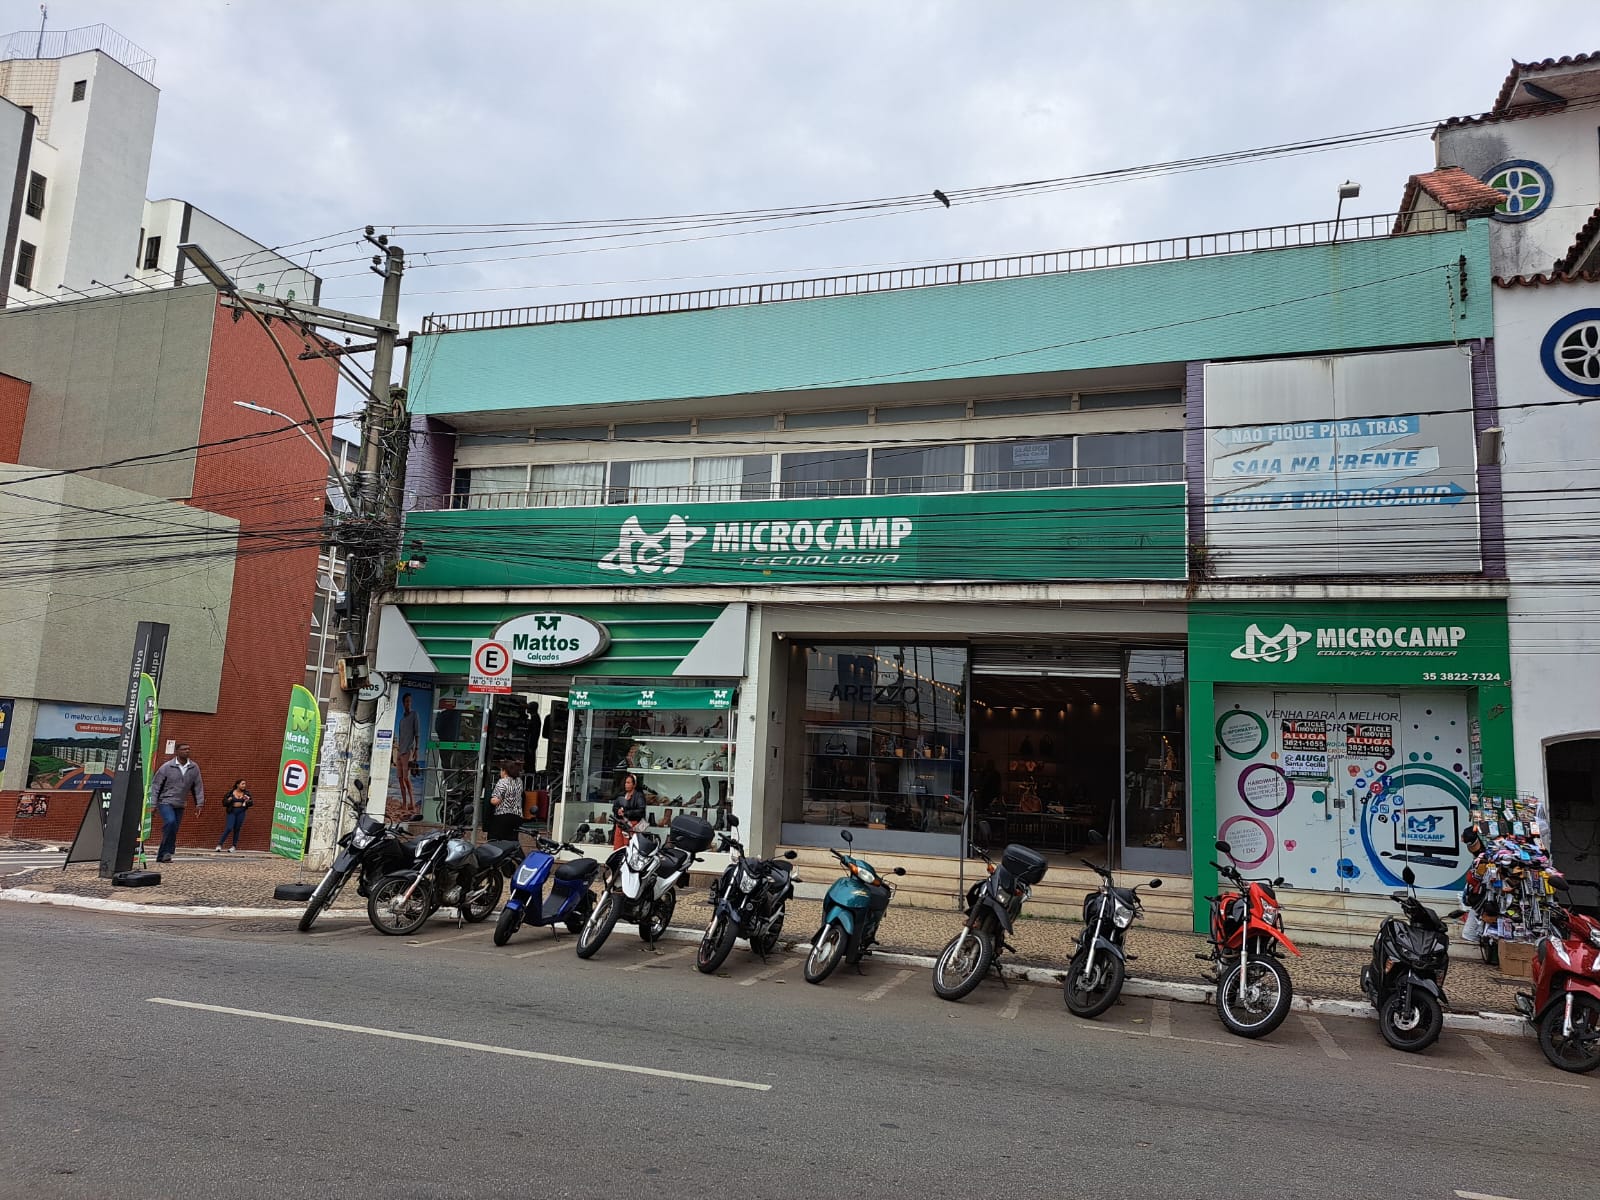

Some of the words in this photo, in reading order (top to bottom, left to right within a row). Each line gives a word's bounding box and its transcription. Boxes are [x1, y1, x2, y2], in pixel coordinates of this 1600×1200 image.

[1269, 425, 1315, 441] FIQUE
[1320, 421, 1362, 437] PARA
[1366, 417, 1409, 433] TRÁS
[1232, 458, 1282, 475] SAIA
[1290, 455, 1321, 472] NA
[1328, 450, 1420, 471] FRENTE
[1301, 486, 1453, 508] MICROCAMP
[711, 516, 914, 552] MICROCAMP
[738, 553, 901, 567] TECNOLOGIA
[513, 633, 580, 651] Mattos
[1316, 626, 1466, 648] MICROCAMP
[485, 650, 499, 669] E
[527, 652, 560, 662] Calçados
[1316, 649, 1377, 657] EDUCAÇÃO
[1380, 649, 1458, 657] TECNOLÓGICA
[132, 649, 144, 678] Silva
[1422, 672, 1437, 681] 35
[1440, 672, 1501, 681] 3822-7324
[828, 684, 919, 704] AREZZO
[123, 682, 140, 730] Augusto
[1265, 709, 1303, 719] VENHA
[1306, 710, 1336, 720] PARA
[1338, 711, 1347, 720] A
[71, 713, 92, 721] melhor
[121, 731, 131, 746] Dr.
[1347, 737, 1391, 746] ALUGA
[1347, 744, 1390, 753] 3821-1055
[117, 747, 129, 772] Pça
[285, 766, 302, 788] E
